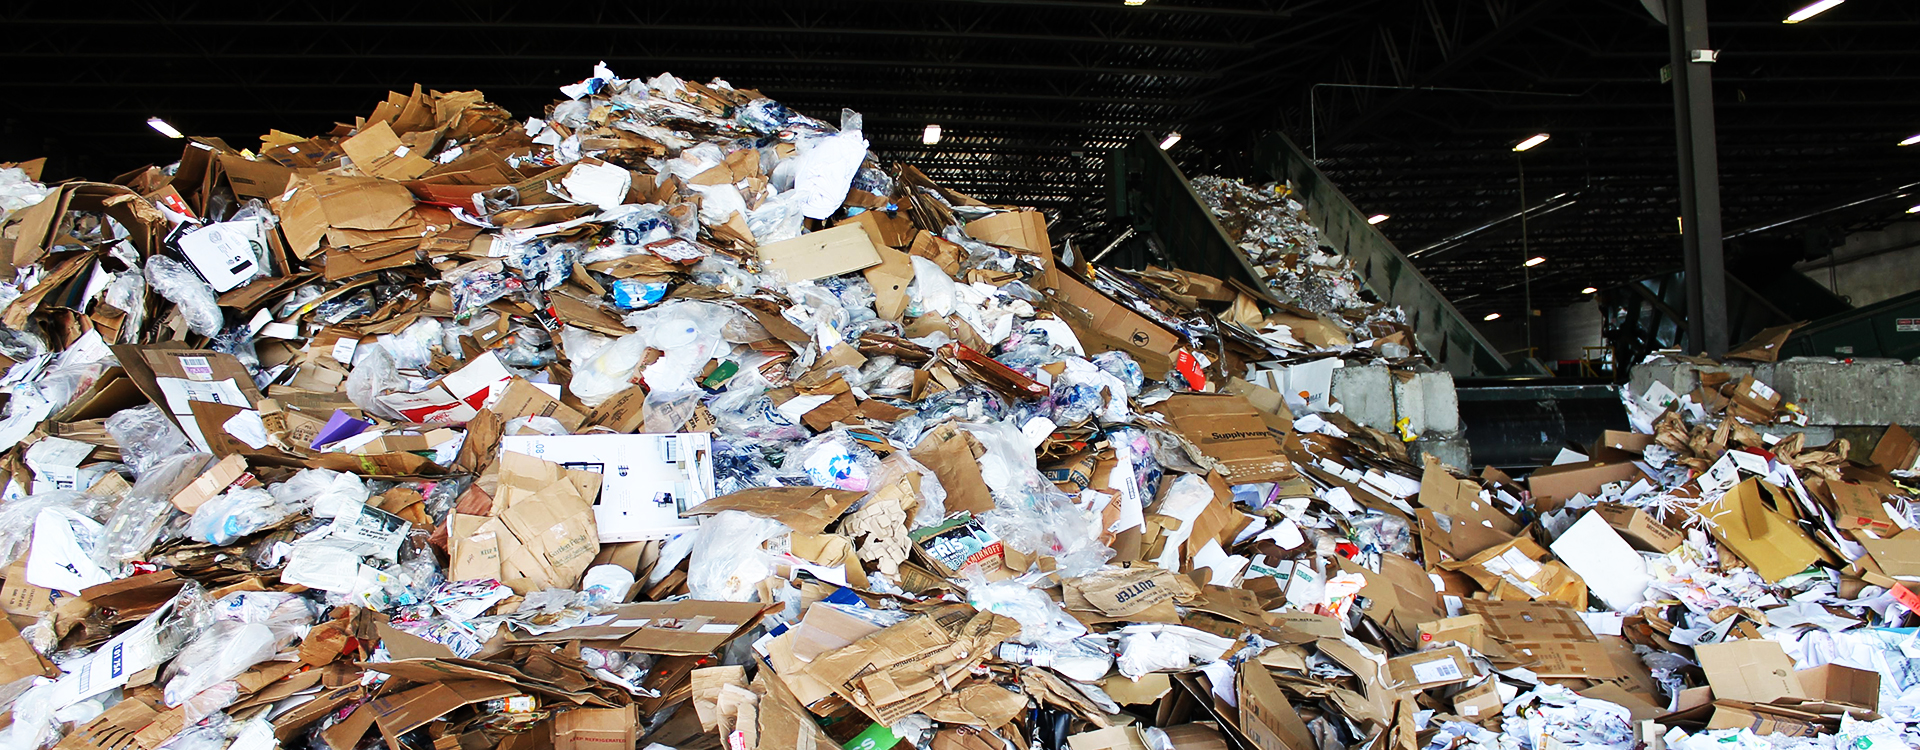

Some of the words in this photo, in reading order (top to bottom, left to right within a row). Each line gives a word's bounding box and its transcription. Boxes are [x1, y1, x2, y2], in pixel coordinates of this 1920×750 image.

[1211, 431, 1272, 440] Supplyways
[549, 543, 571, 557] Garden
[571, 534, 586, 546] Fresh
[967, 543, 1001, 566] SMIRNOFF
[1115, 580, 1156, 603] BUTTER
